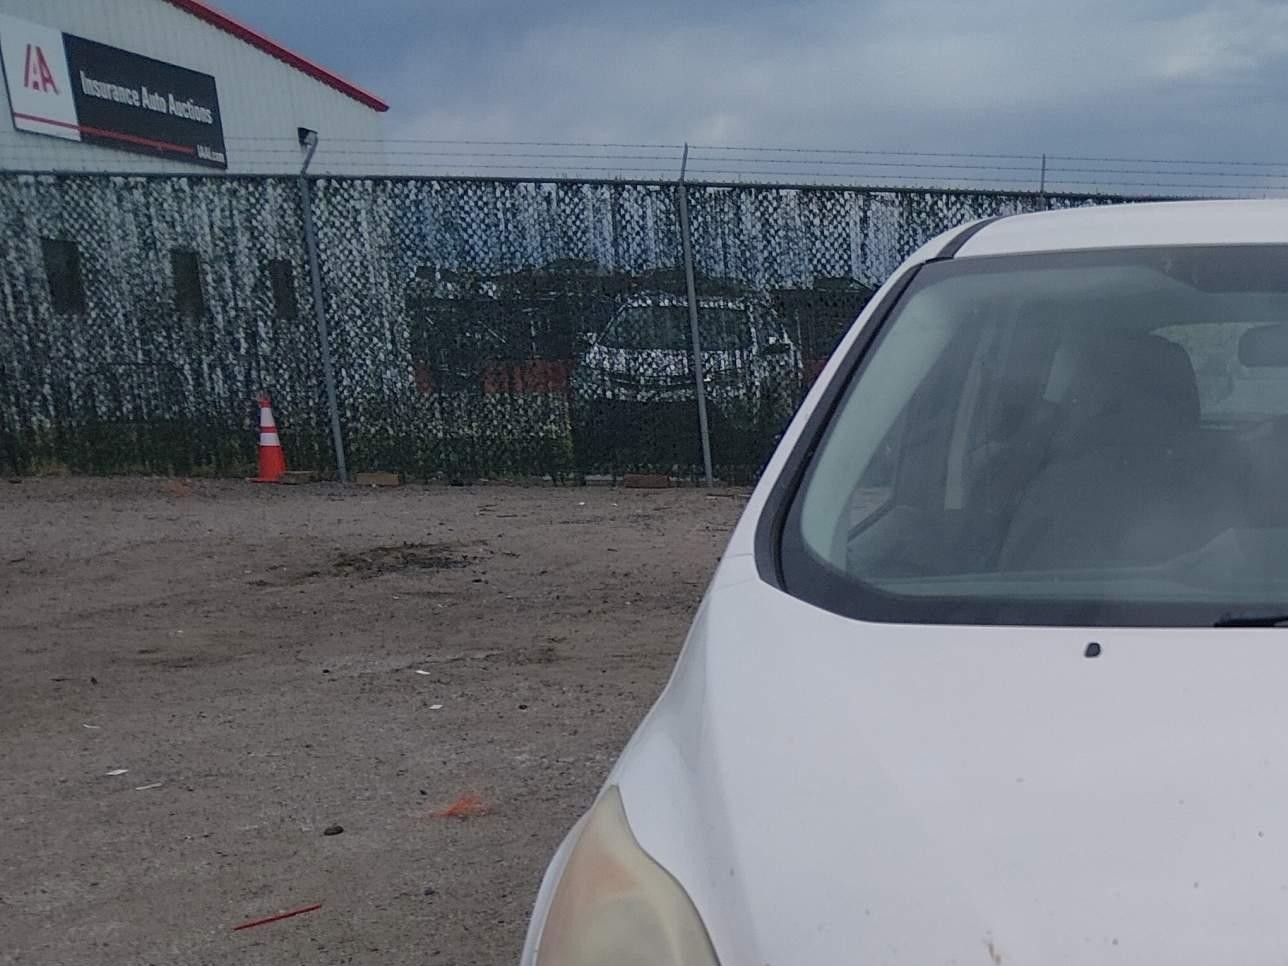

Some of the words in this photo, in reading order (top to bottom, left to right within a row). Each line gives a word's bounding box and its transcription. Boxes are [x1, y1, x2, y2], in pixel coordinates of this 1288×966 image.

[80, 70, 140, 107] Insurance
[141, 86, 167, 114] Auto
[168, 93, 213, 125] Auctions
